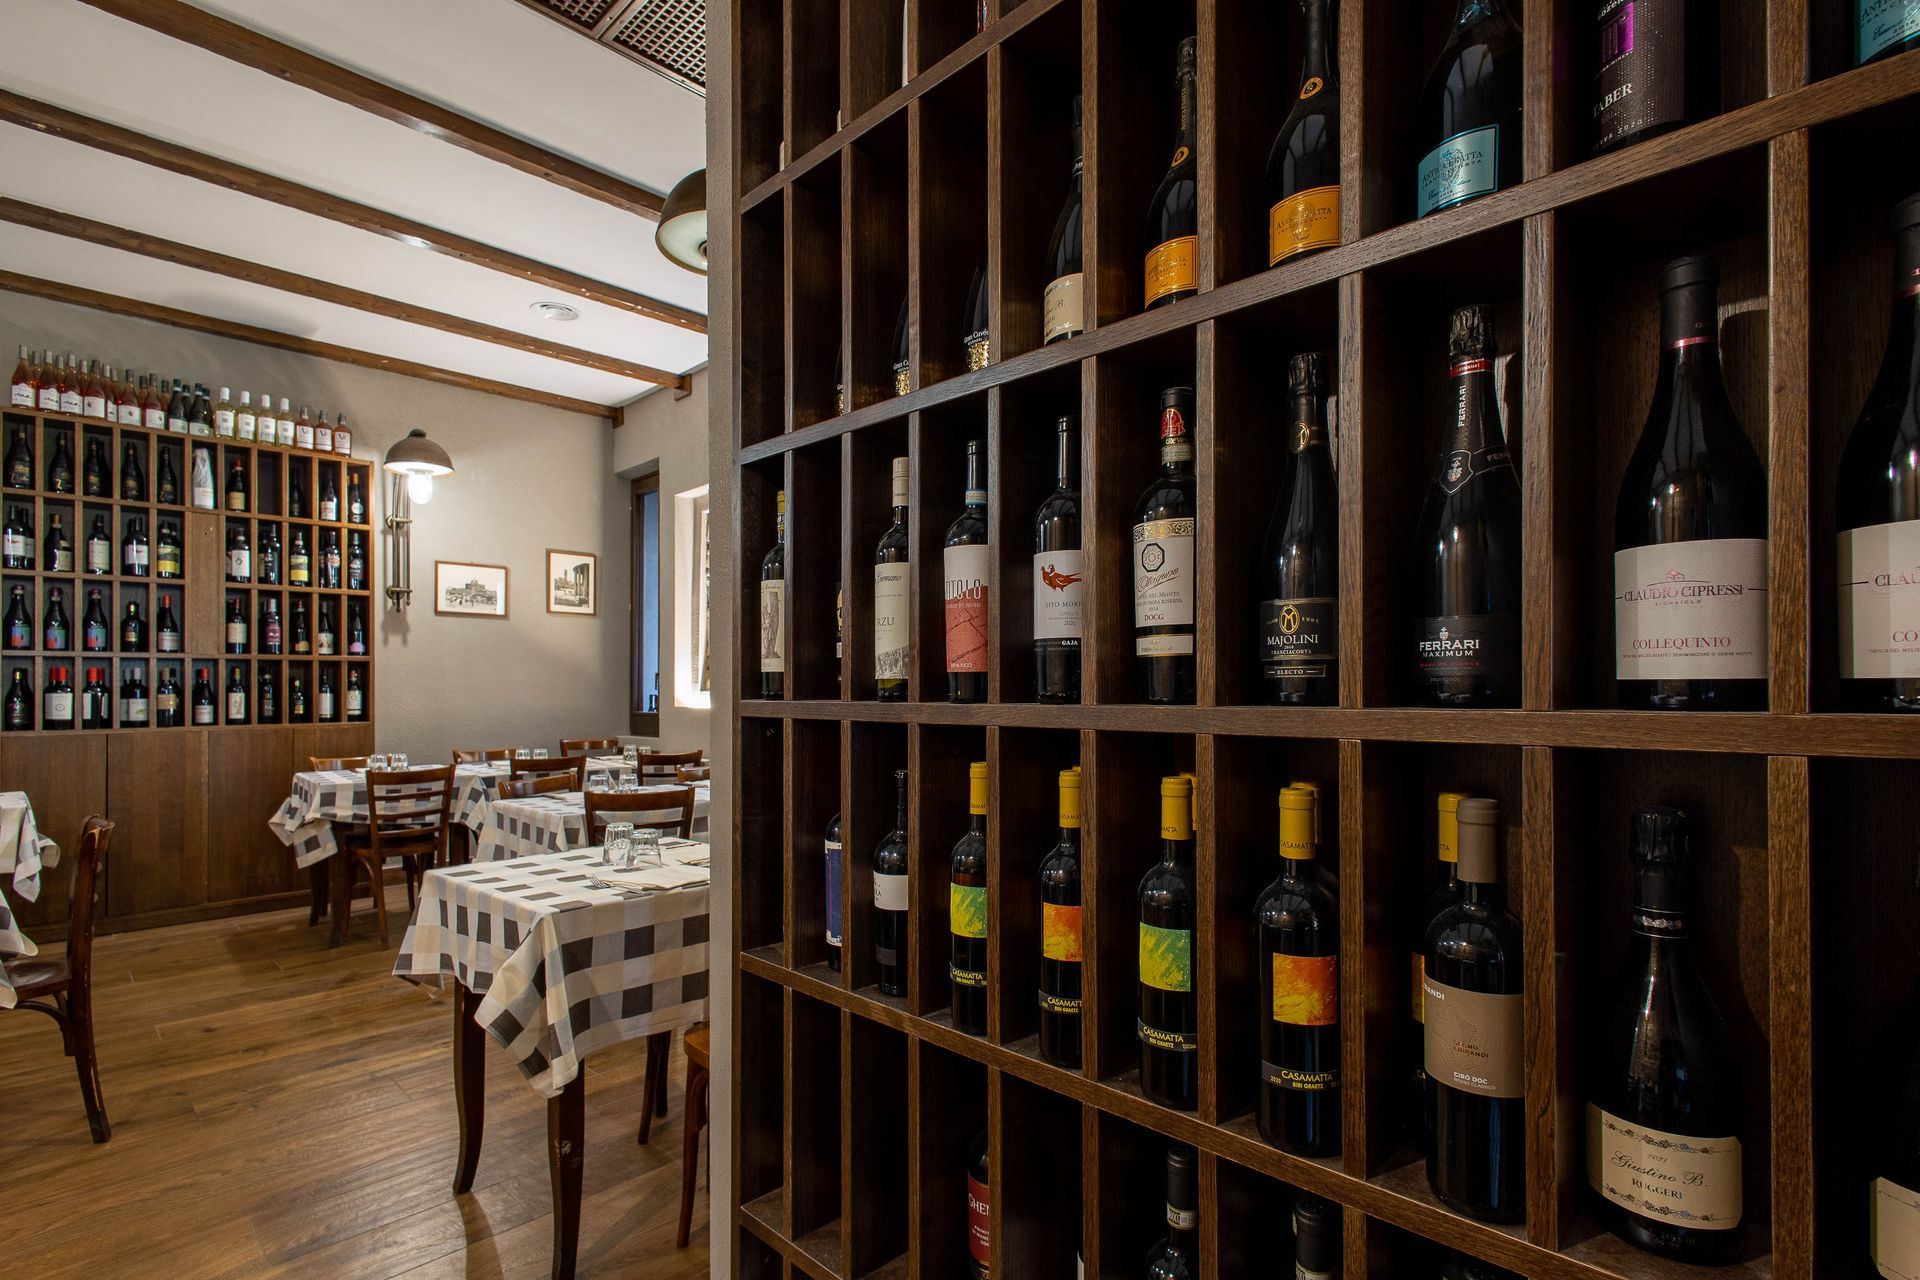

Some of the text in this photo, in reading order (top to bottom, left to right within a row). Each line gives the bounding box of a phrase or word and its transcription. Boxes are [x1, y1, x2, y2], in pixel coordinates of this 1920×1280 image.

[1457, 385, 1467, 427] FERRARI
[1624, 584, 1743, 602] CLAUDIO CIPRESSI
[1144, 613, 1165, 621] DOCG
[1267, 634, 1319, 647] MAJOLINI
[1419, 639, 1480, 651] FERRARI
[1632, 636, 1732, 650] COLLEQUINTO
[1423, 650, 1474, 658] MAXIMUM
[952, 968, 983, 980] CASAMATTA
[1047, 996, 1082, 1007] CASAMATT
[1143, 1026, 1184, 1043] CASAMATTA
[1281, 1070, 1334, 1082] CASAMATTA
[1472, 1076, 1488, 1085] DOC
[1611, 1151, 1677, 1182] Giustino
[1632, 1178, 1683, 1200] RUGGERI
